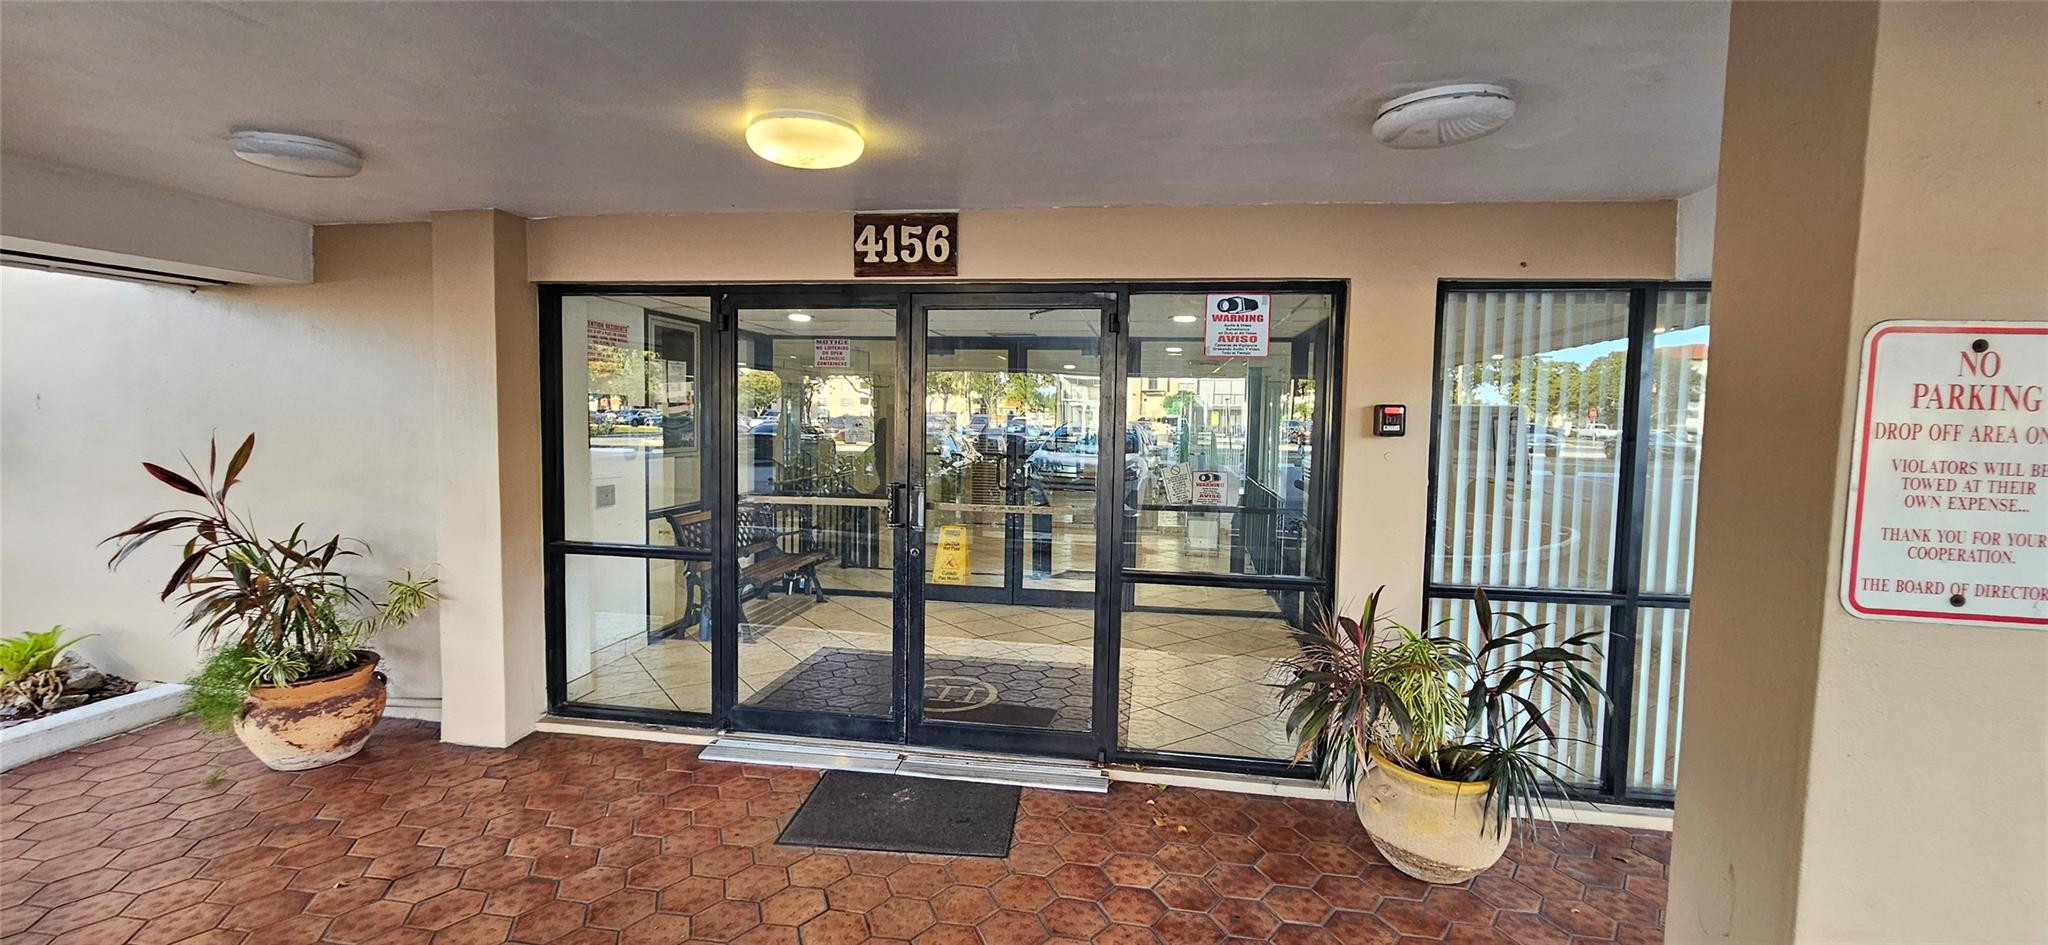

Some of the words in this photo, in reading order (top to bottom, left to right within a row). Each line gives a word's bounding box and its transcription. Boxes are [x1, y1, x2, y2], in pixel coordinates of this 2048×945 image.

[855, 224, 950, 263] 4156
[1212, 314, 1264, 322] WARNING
[1957, 351, 2001, 377] NO
[1911, 383, 2043, 412] PARKING
[1874, 423, 1922, 441] DROP
[1929, 424, 1964, 442] OFF
[1969, 425, 2018, 444] AREA
[1892, 459, 1978, 475] VIOLATORS
[1984, 462, 2024, 477] WILL
[2031, 464, 2048, 478] BE
[1901, 477, 1957, 492] TOWED
[1962, 480, 1983, 493] AT
[1988, 480, 2036, 495] THEIR
[1905, 495, 1942, 509] OWN
[1948, 497, 2030, 513] EXPENSE...
[1881, 527, 1931, 542] THANK
[1937, 530, 1967, 544] YOU
[1972, 531, 2001, 546] FOR
[2007, 533, 2048, 548] YOUR
[1907, 546, 2016, 564] COOPERATION.
[1861, 578, 1890, 592] THE
[1896, 579, 1944, 595] BOARD
[1950, 583, 1970, 596] OF
